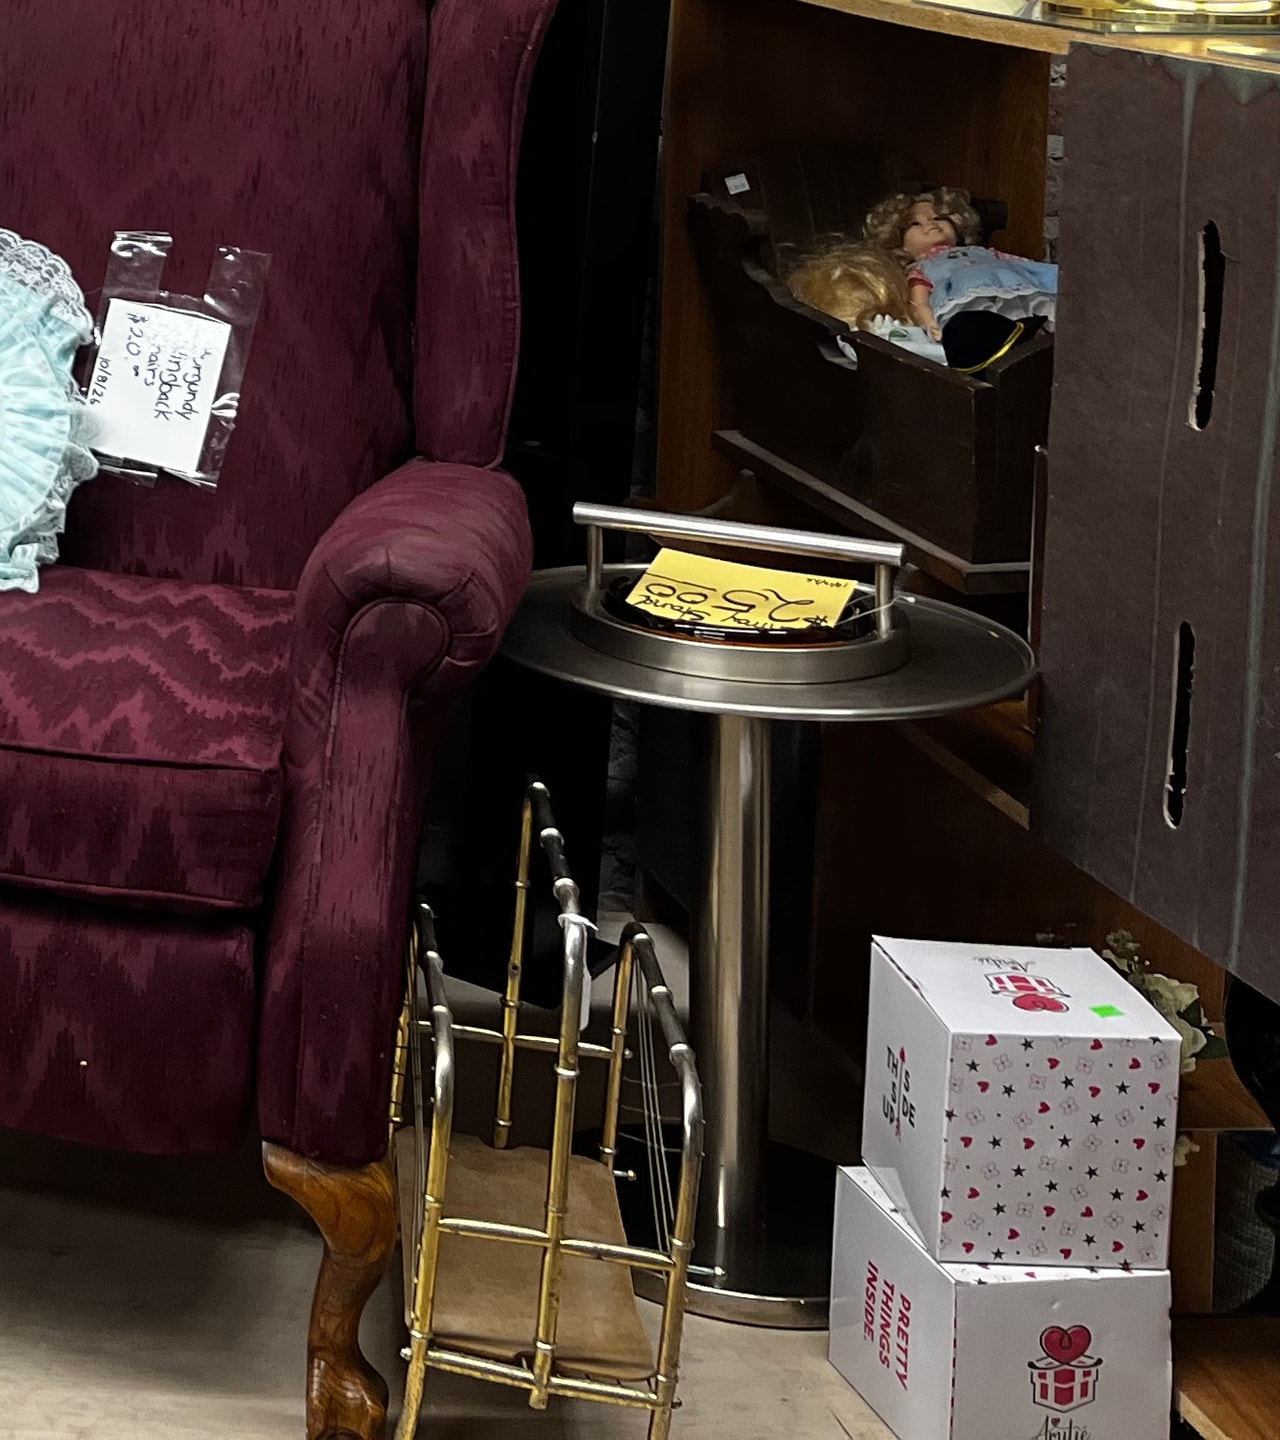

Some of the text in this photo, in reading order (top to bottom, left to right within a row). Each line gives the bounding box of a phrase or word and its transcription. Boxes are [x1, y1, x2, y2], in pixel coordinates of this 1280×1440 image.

[90, 357, 110, 406] 10/8/26
[154, 352, 188, 422] ingback
[175, 349, 212, 421] urgundy
[863, 1258, 878, 1342] INSIDE.
[879, 1278, 895, 1369] THINGS
[895, 1291, 912, 1391] PRETTY
